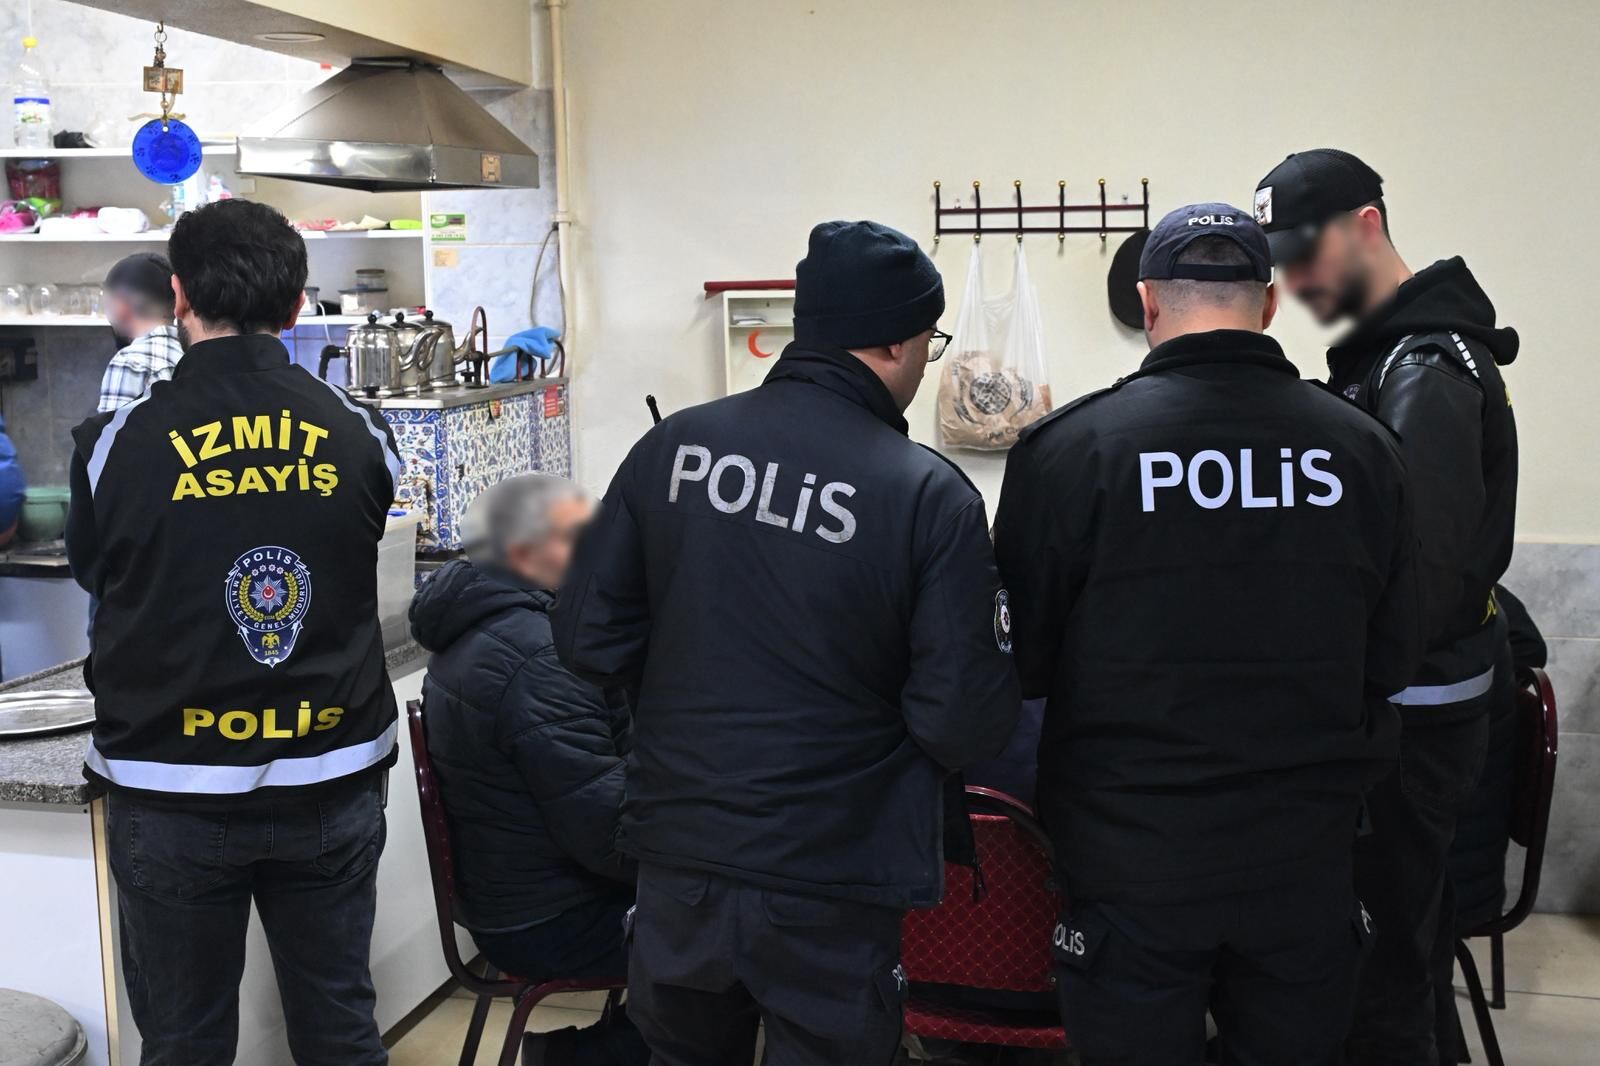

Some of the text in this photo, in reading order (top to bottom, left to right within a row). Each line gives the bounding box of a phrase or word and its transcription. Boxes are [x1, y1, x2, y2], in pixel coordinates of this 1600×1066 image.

[168, 409, 329, 469] İZMİT
[171, 458, 339, 501] ASAYİŞ
[243, 550, 292, 567] POLİS
[254, 621, 286, 629] GENEL
[183, 701, 344, 740] POLİS
